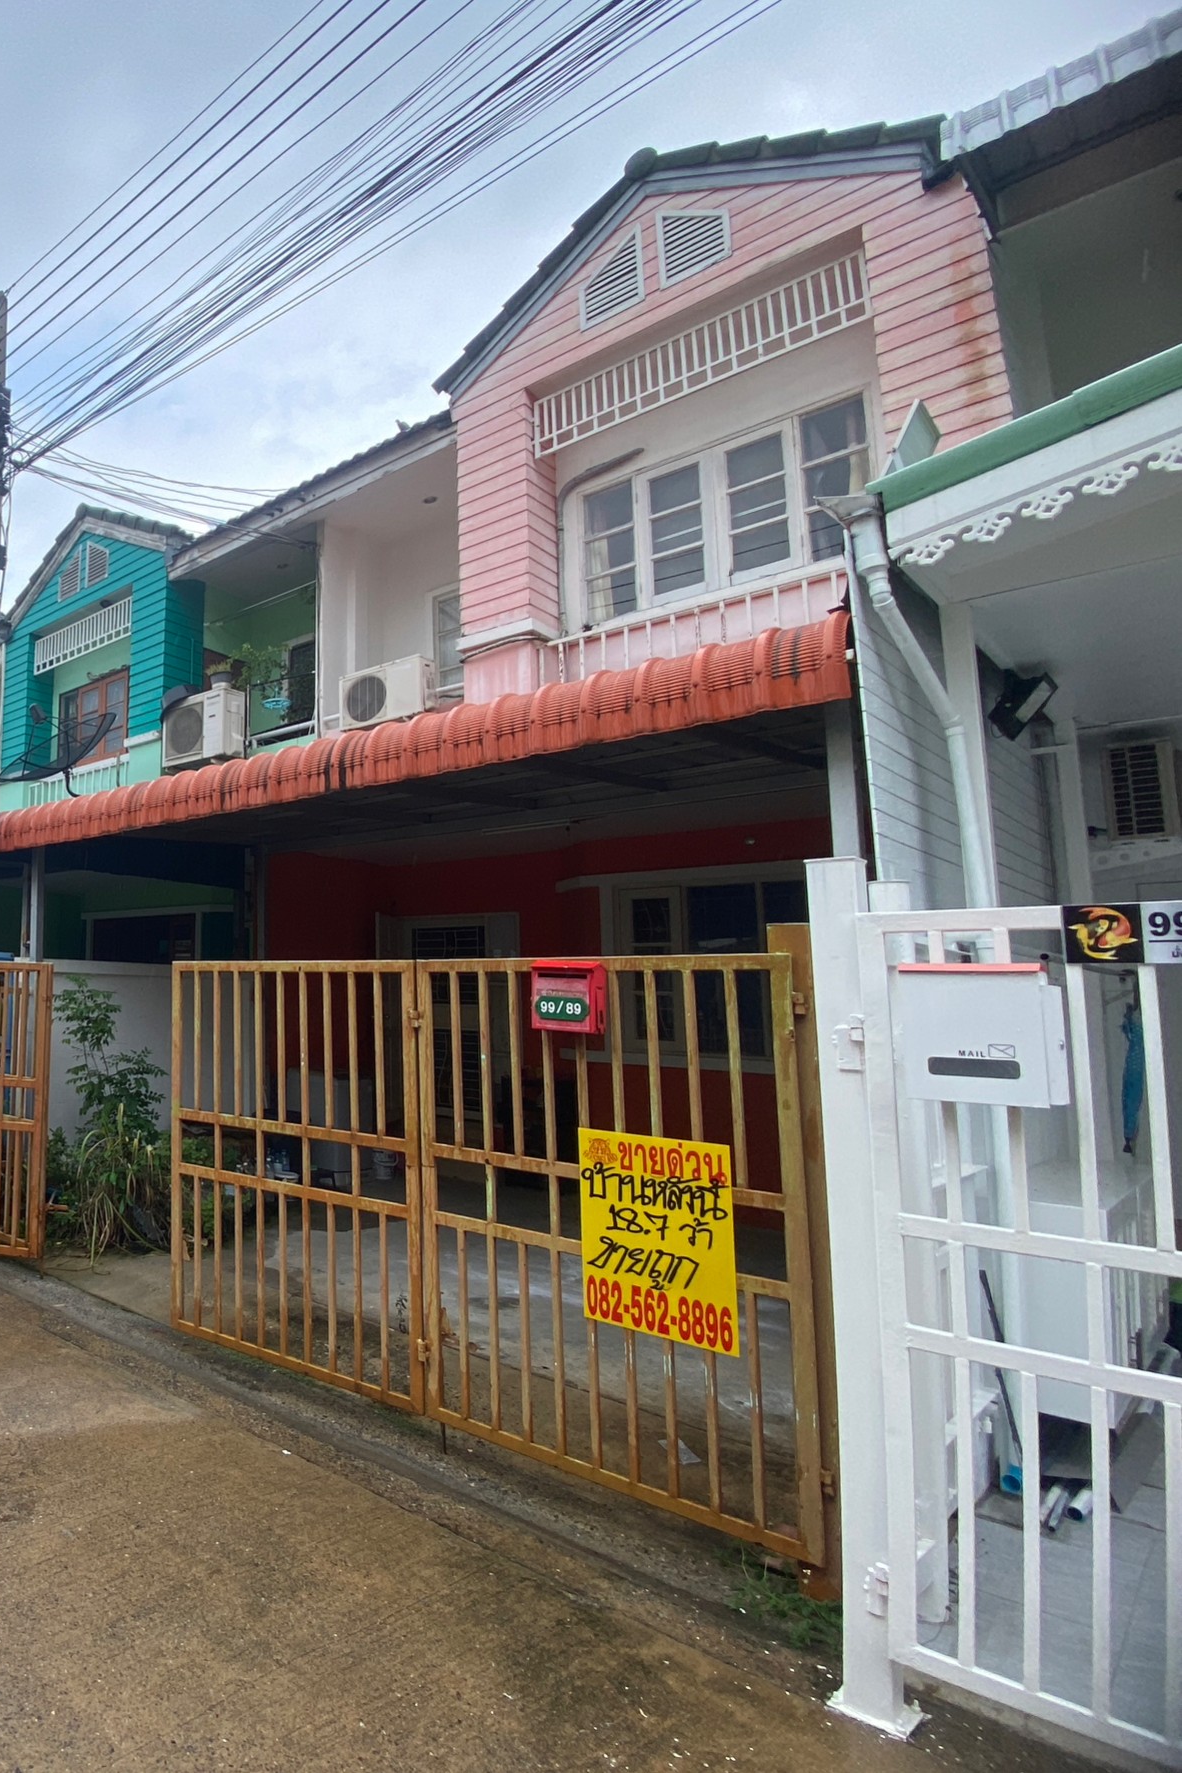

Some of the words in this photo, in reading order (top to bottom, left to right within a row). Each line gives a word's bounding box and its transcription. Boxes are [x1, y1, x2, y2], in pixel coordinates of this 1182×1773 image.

[540, 1000, 581, 1014] 99/89
[958, 1050, 986, 1058] MAIL
[618, 1142, 728, 1186] ขายด่วน
[606, 1204, 670, 1241] 18.7
[587, 1236, 700, 1290] ขายถูก
[587, 1275, 734, 1352] 082-562-8896
